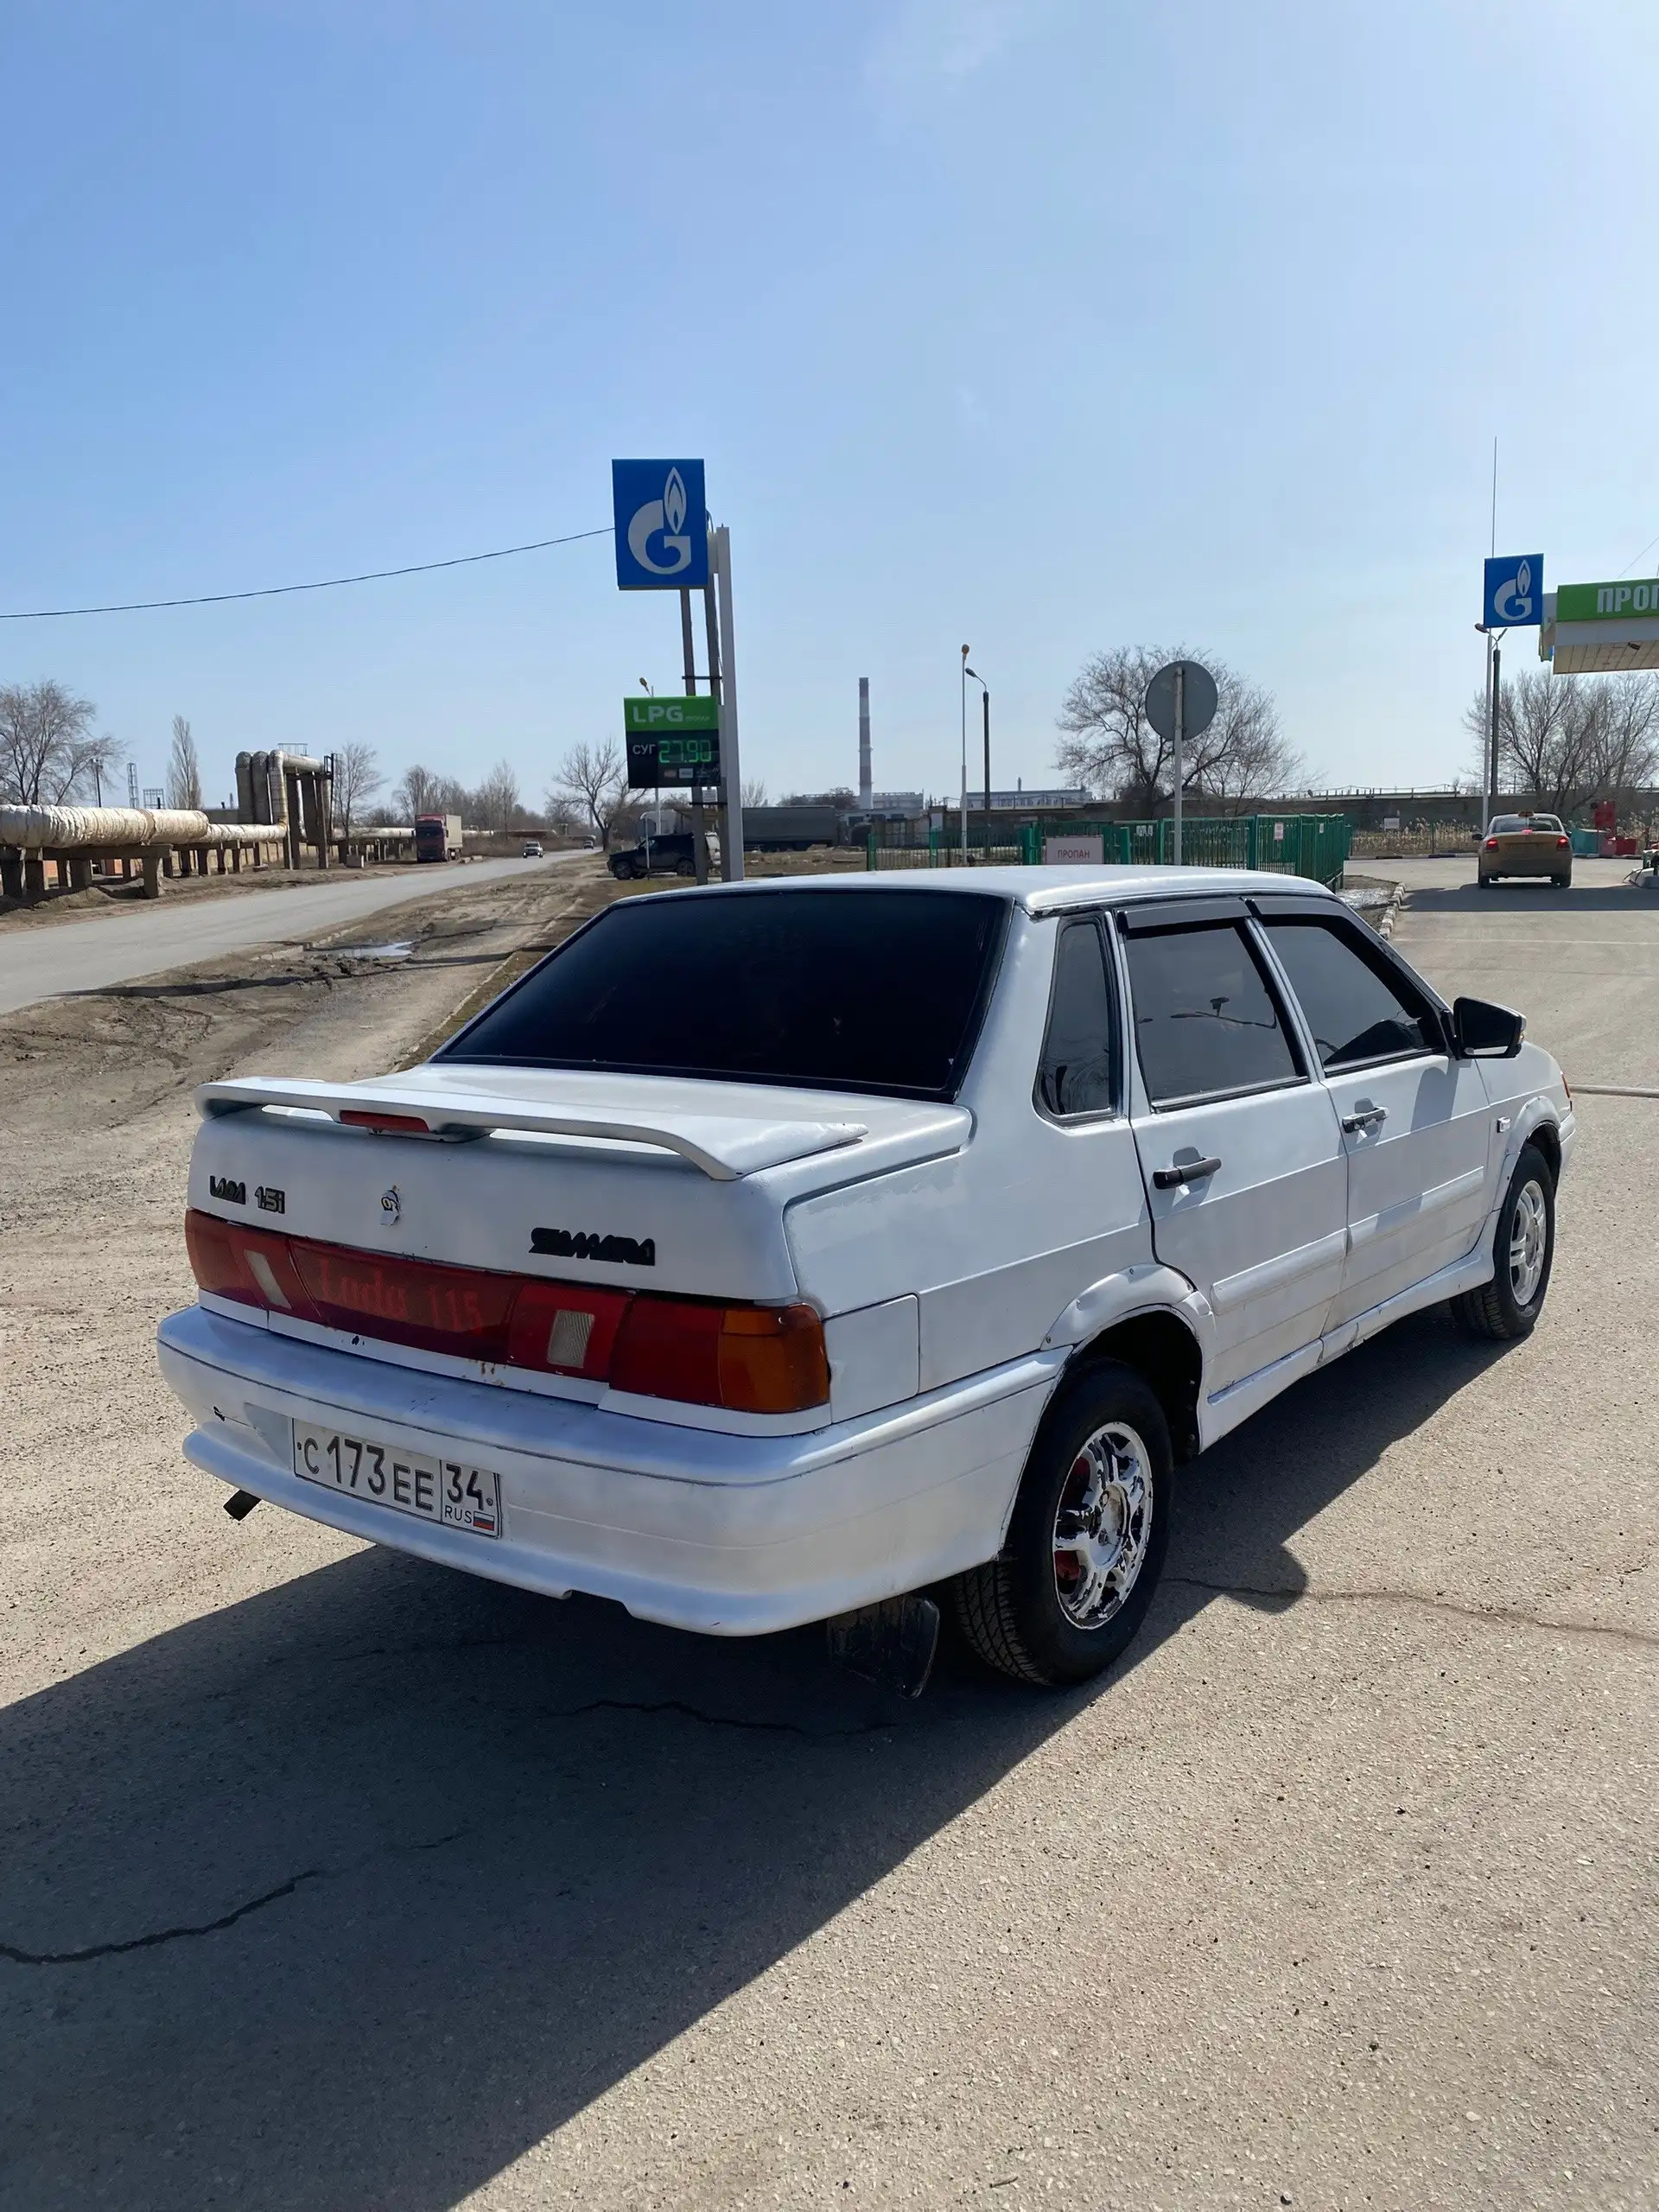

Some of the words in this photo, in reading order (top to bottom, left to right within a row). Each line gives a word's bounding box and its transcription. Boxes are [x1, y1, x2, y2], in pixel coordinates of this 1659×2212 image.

[632, 705, 683, 722] LPG
[632, 744, 656, 755] СУГ
[1058, 849, 1090, 859] ПРОПАН
[444, 1504, 473, 1524] RUS
